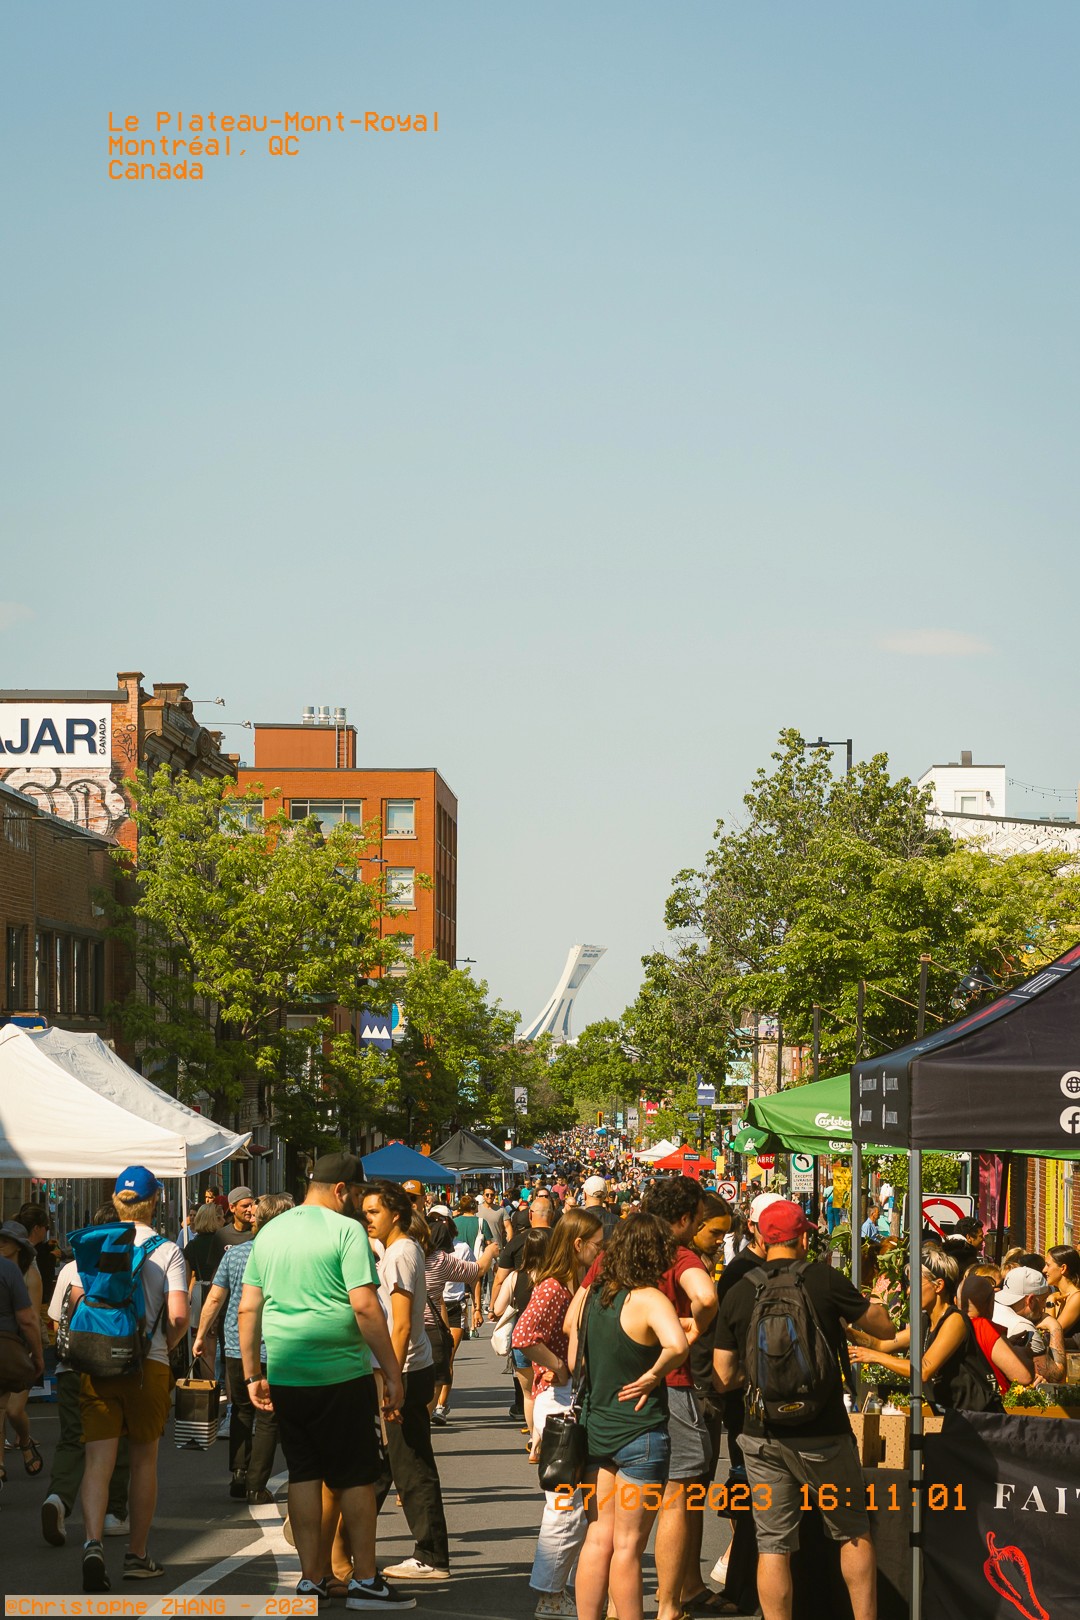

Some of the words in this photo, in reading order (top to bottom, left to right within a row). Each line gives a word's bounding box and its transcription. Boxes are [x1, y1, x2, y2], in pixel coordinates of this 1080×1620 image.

[0, 718, 97, 754] JAR
[98, 717, 106, 755] CANADA
[815, 1112, 852, 1128] Carlsber
[757, 1155, 774, 1163] ARRÊ
